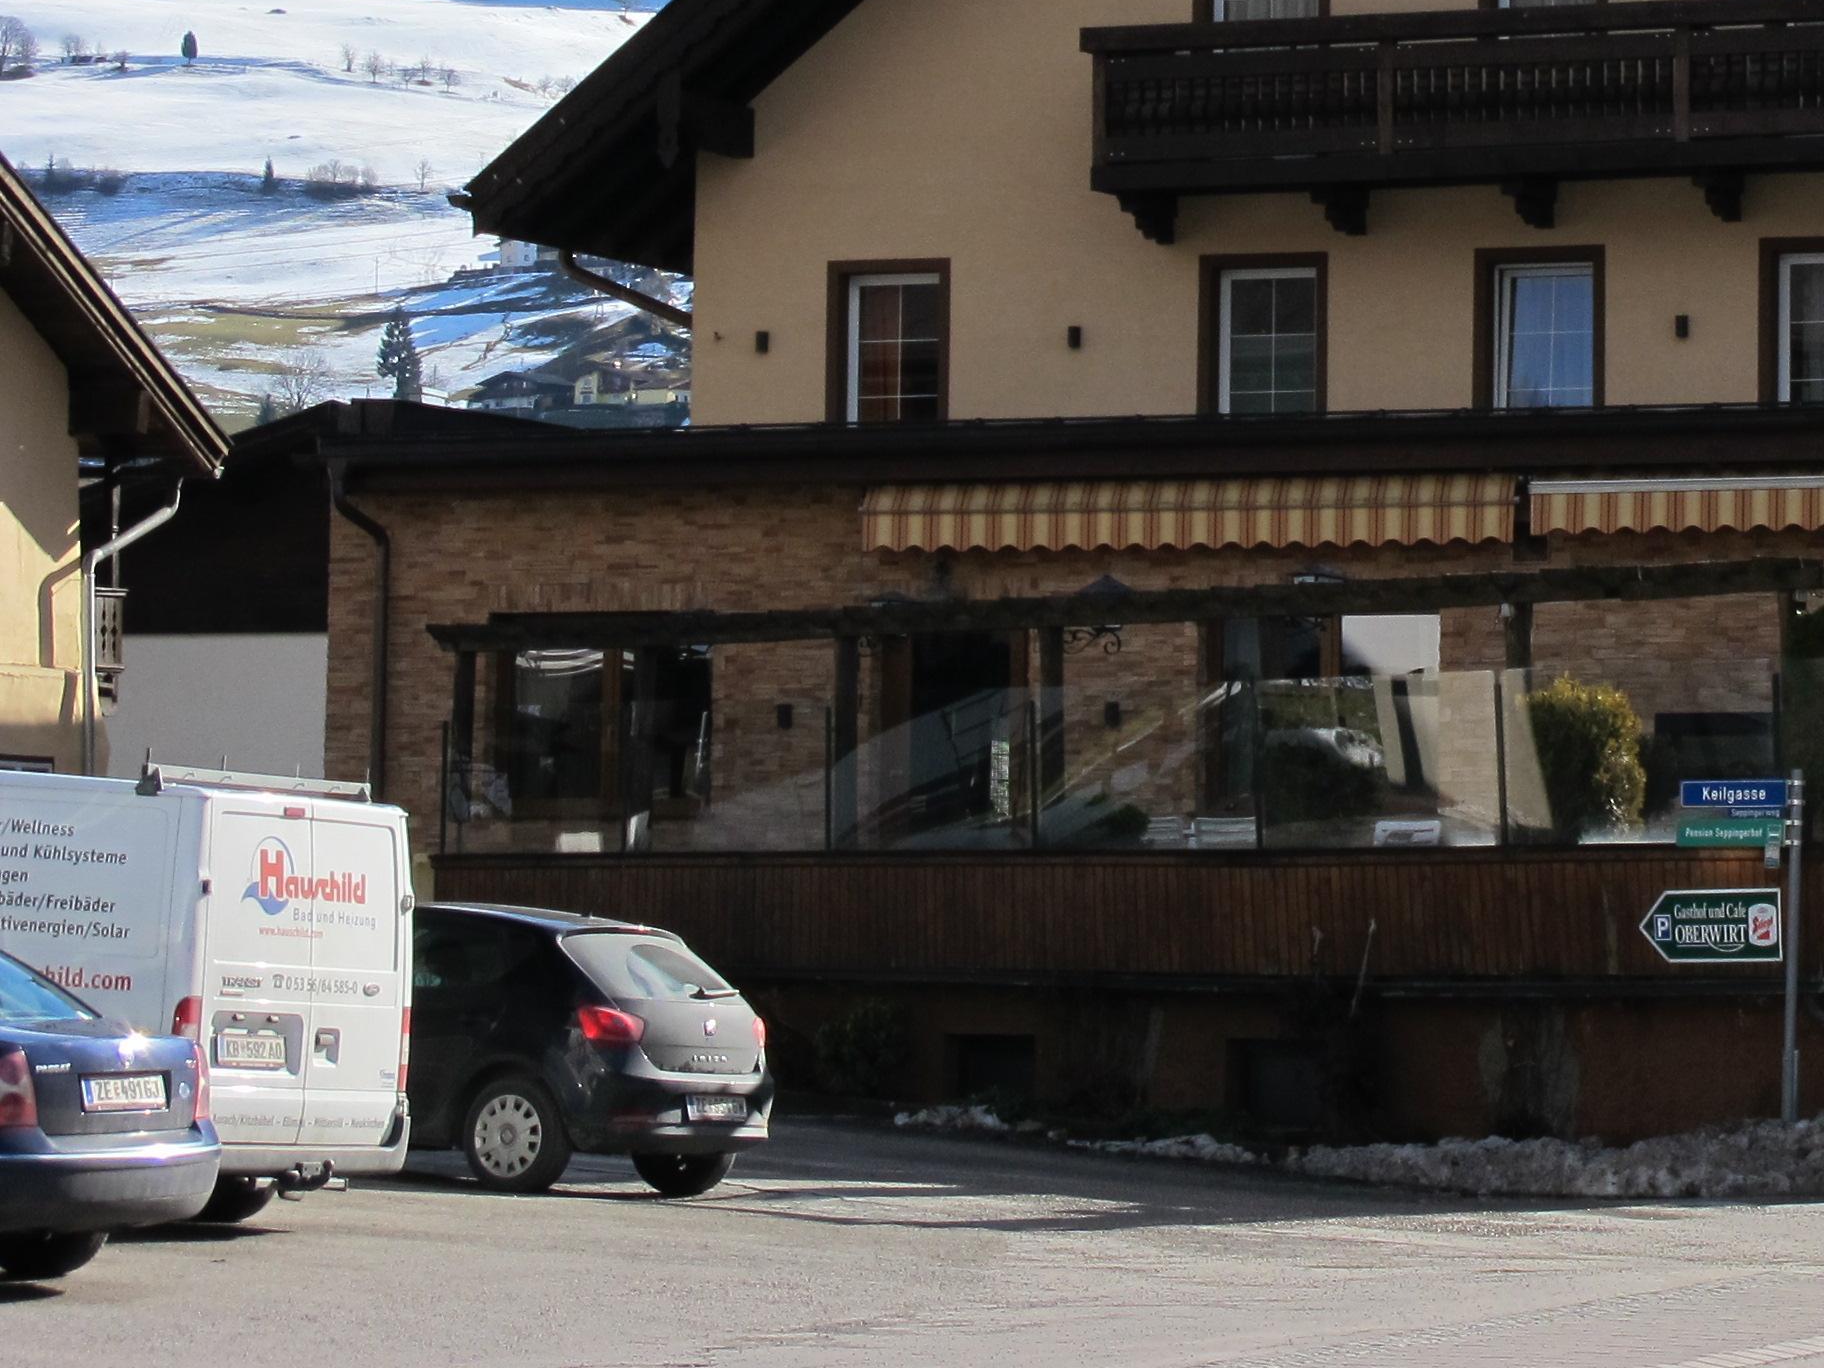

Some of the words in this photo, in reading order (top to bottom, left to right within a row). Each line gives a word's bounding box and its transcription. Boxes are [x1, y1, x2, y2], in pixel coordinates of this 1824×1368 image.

[1702, 786, 1767, 804] Keilgasse
[1685, 827, 1713, 837] Pension
[1715, 827, 1763, 840] Seppingerhof
[1, 843, 29, 858] und
[33, 844, 128, 865] Kühlsysteme
[260, 849, 366, 905] Hauschild
[293, 907, 313, 922] Bad
[316, 911, 336, 925] und
[338, 912, 377, 930] Heizung
[1674, 903, 1707, 919] Gasthof
[1709, 903, 1725, 918] und
[1674, 924, 1747, 944] OBERWIRT
